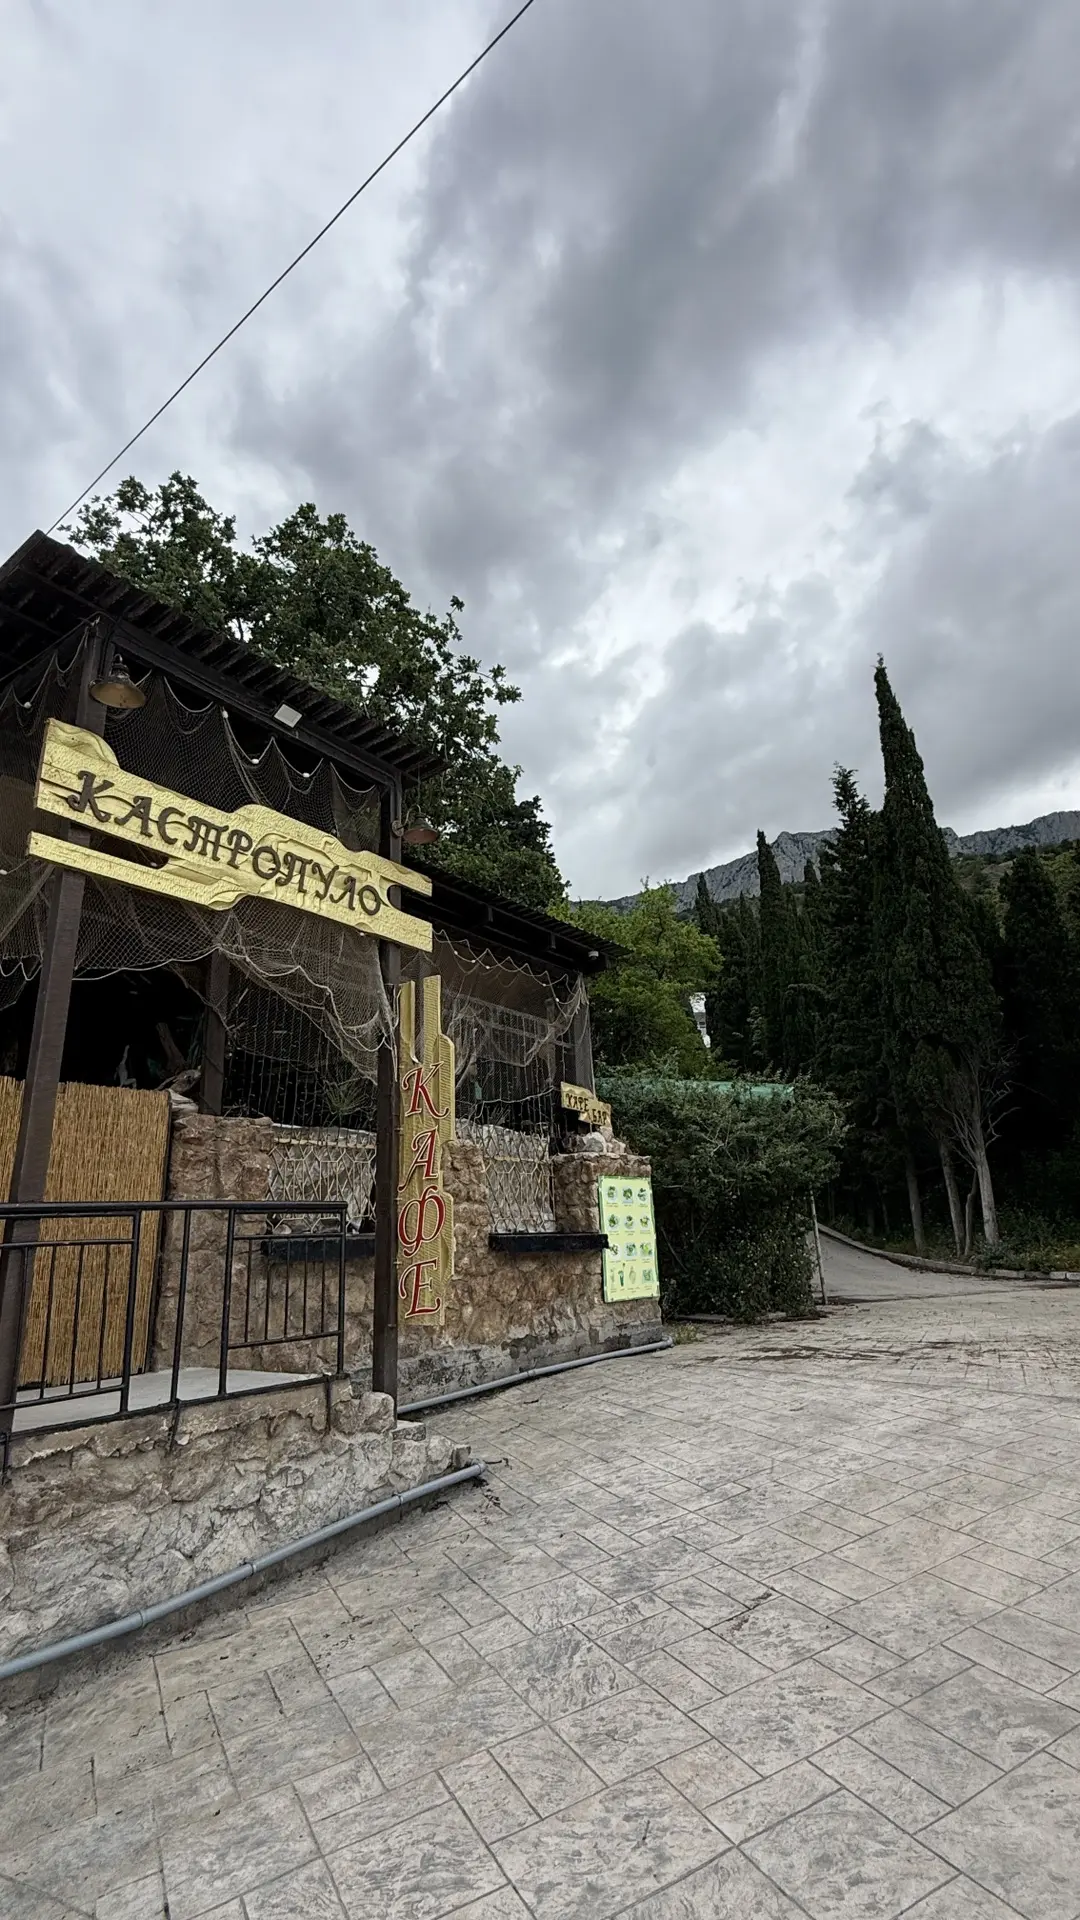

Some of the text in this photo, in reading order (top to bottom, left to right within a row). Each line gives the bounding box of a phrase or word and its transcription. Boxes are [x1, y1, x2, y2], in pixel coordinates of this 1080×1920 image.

[66, 770, 382, 916] КАСТРОПУЛО
[398, 1060, 450, 1319] КАФЕ
[592, 1108, 607, 1126] БАР
